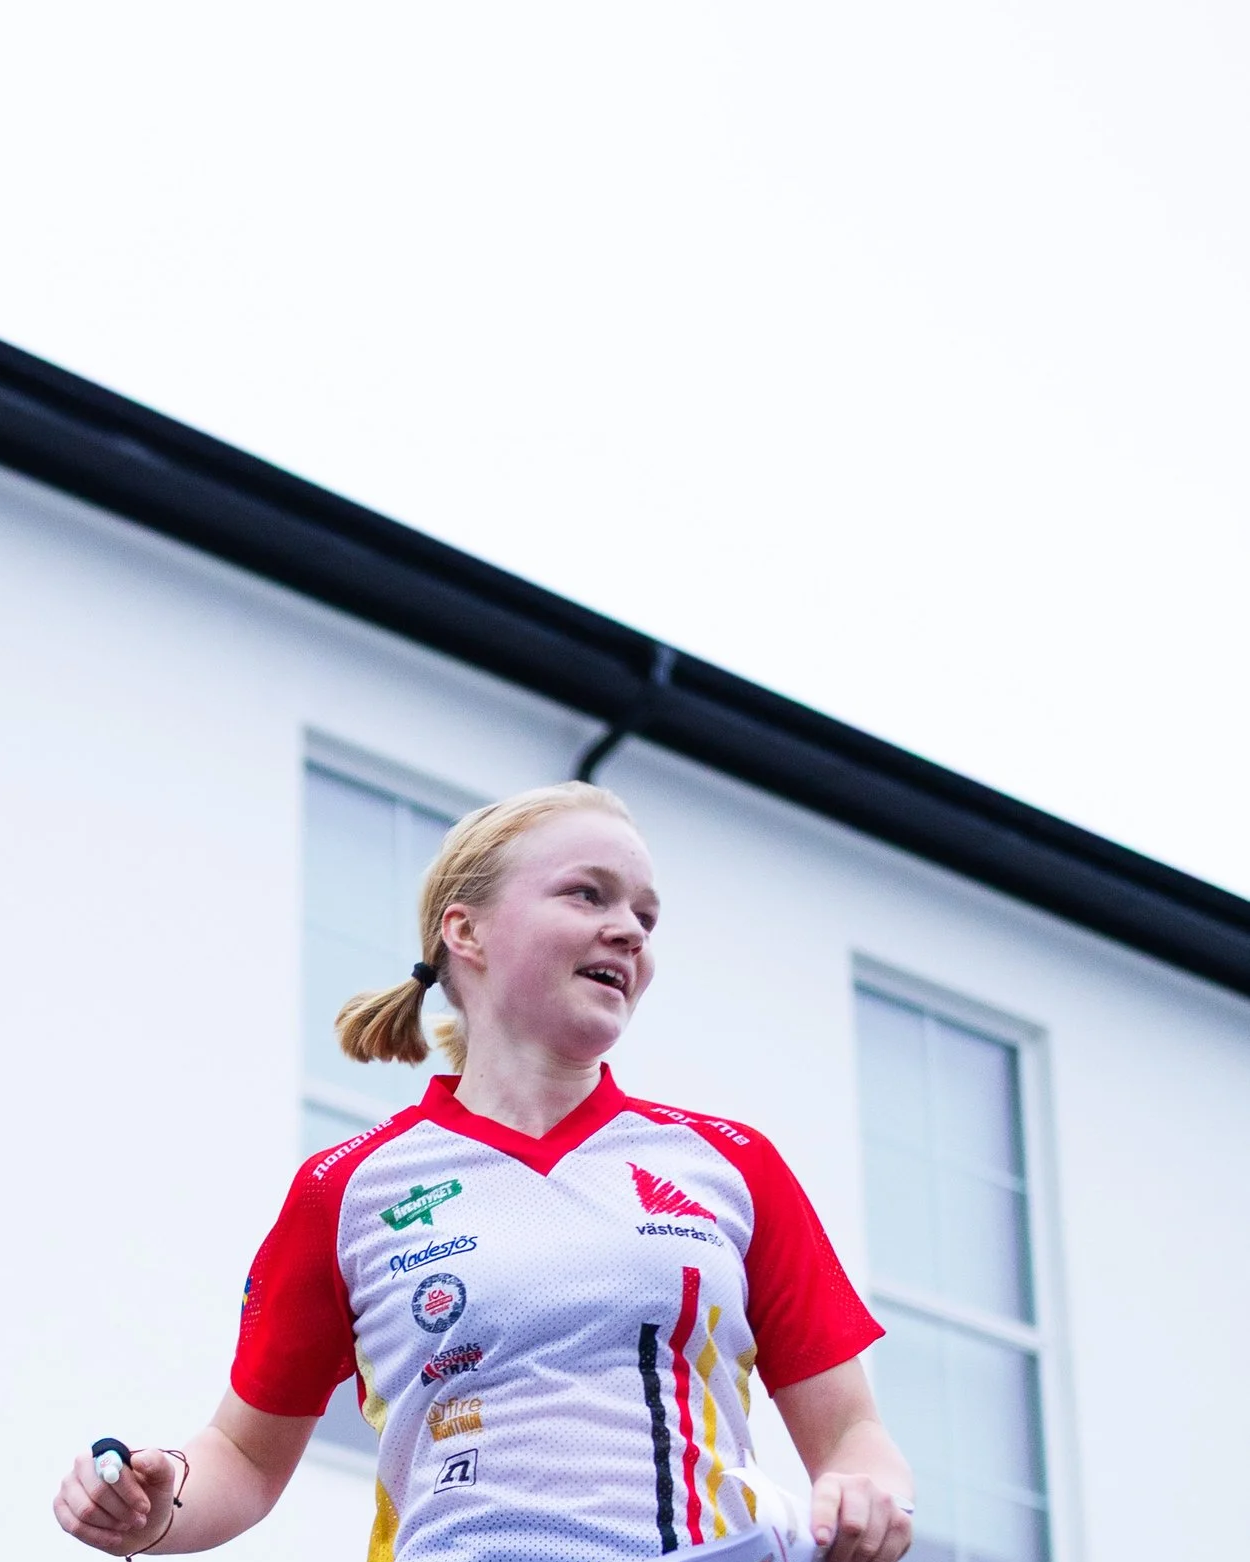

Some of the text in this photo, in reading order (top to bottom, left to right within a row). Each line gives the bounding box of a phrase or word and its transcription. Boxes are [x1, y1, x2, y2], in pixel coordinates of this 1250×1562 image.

[635, 1222, 707, 1242] västerås
[427, 1289, 446, 1302] ICA
[434, 1350, 483, 1372] POWER
[446, 1396, 482, 1417] fire
